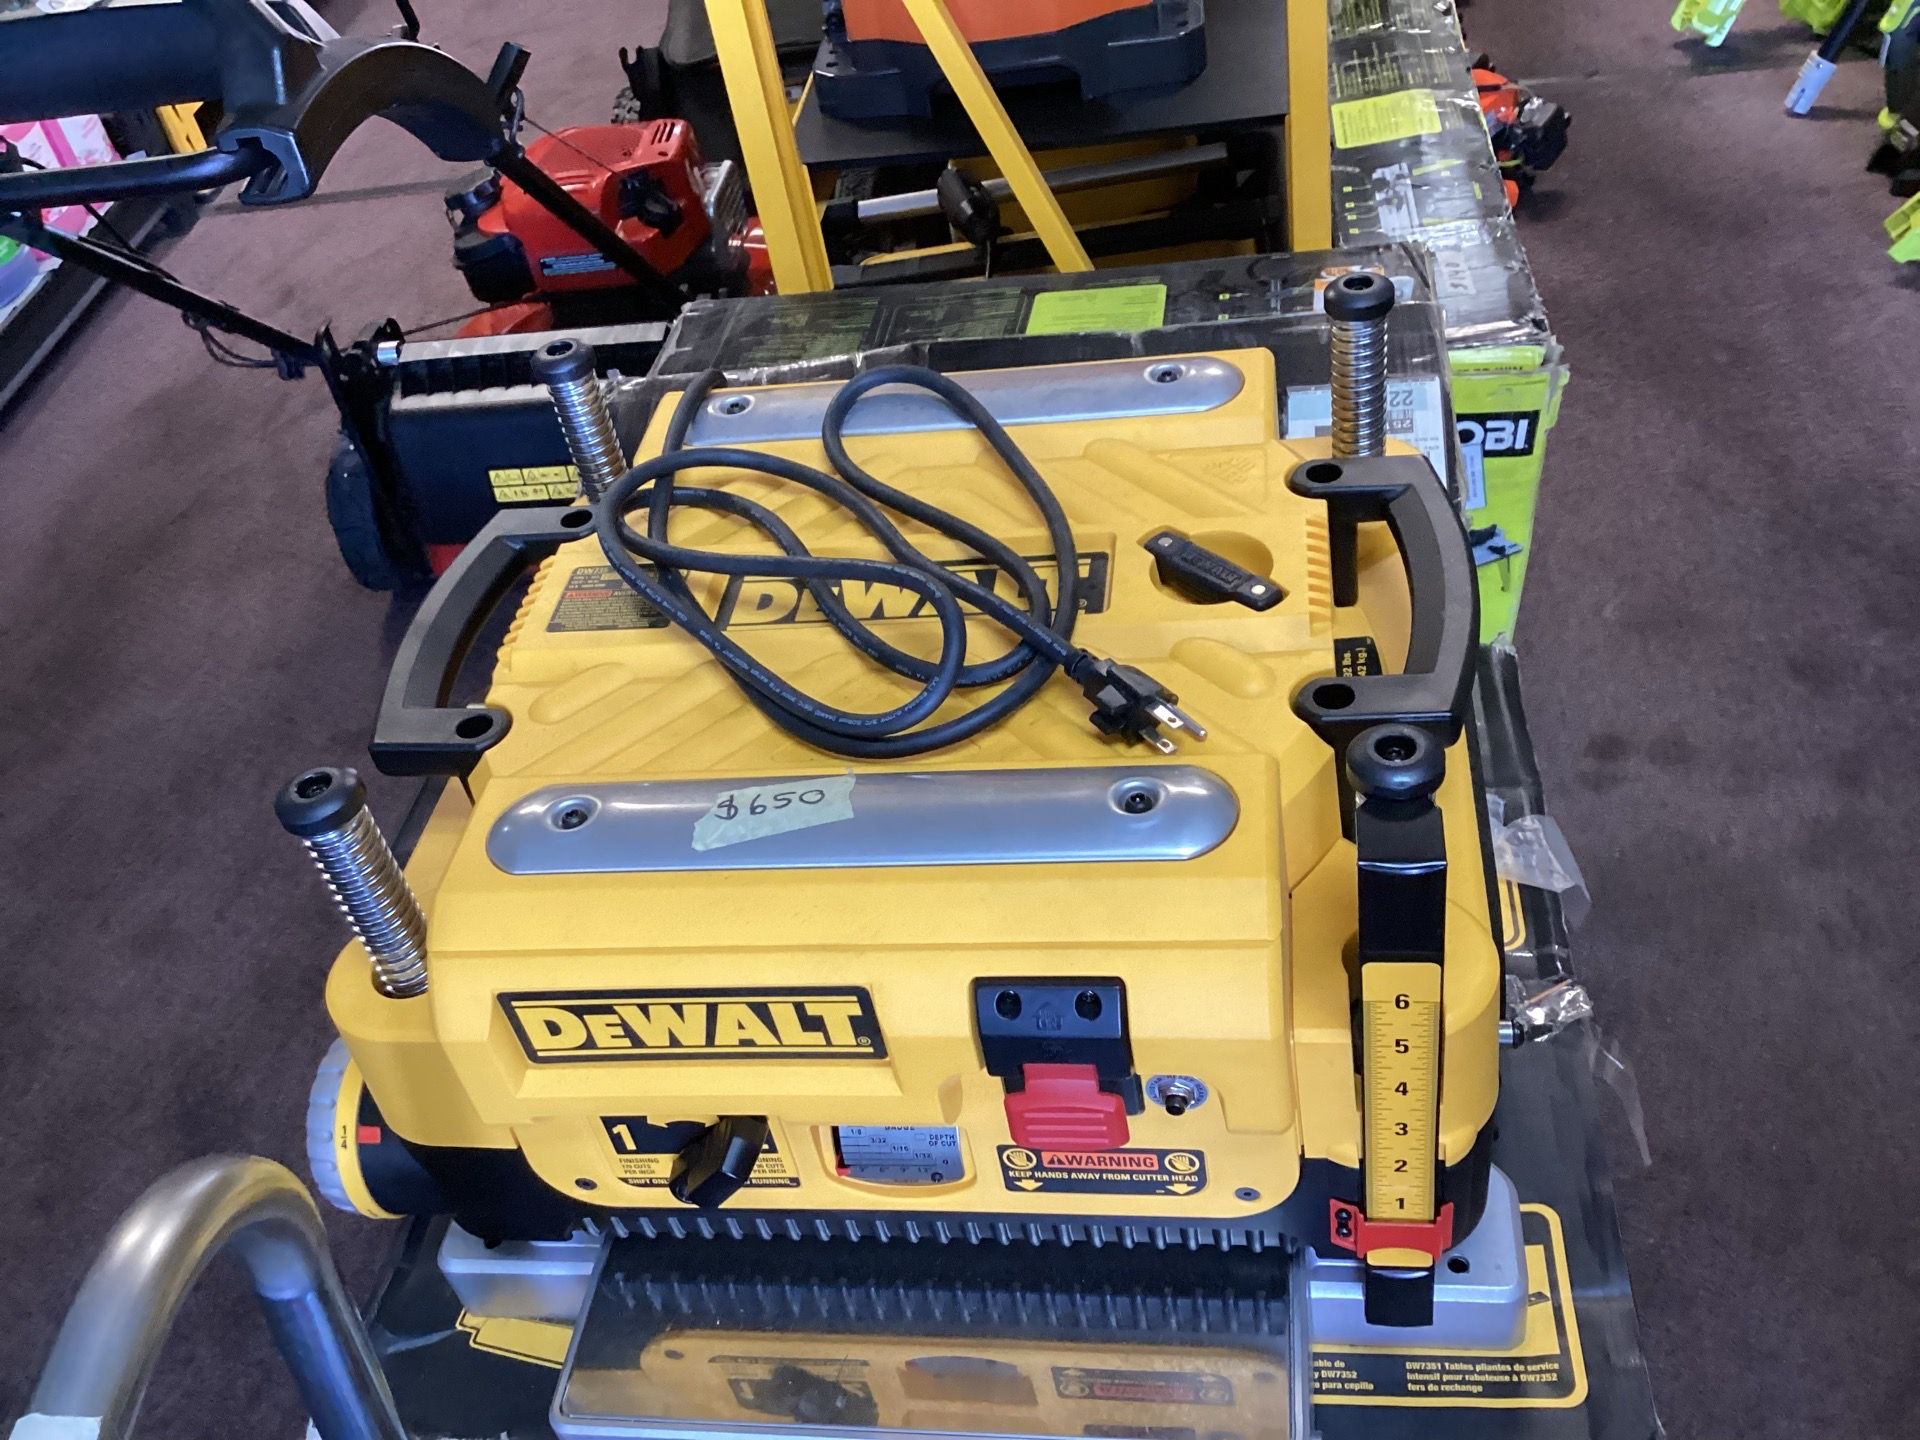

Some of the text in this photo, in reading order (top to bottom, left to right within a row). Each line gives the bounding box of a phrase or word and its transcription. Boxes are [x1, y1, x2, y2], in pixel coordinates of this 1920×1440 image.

[1457, 418, 1529, 451] OBI
[714, 789, 825, 820] $650
[1394, 993, 1410, 1009] 6
[1394, 1038, 1409, 1053] 5
[1394, 1081, 1409, 1096] 4
[1394, 1122, 1409, 1136] 3
[611, 1123, 637, 1150] 1
[1064, 1155, 1155, 1168] WARNING
[1393, 1159, 1408, 1173] 2
[1008, 1170, 1032, 1178] KEEP
[1035, 1171, 1068, 1179] HANDS
[1071, 1172, 1100, 1180] AWAY
[1103, 1173, 1131, 1181] FROM
[1133, 1174, 1169, 1182] CUTTER
[1395, 1197, 1405, 1210] 1
[1334, 1360, 1345, 1368] de
[1405, 1361, 1560, 1373] DW7351 Tables pliantes de service
[1321, 1371, 1358, 1379] DW7352
[1406, 1372, 1441, 1381] intensif
[1442, 1373, 1464, 1383] pour
[1465, 1373, 1510, 1382] raboteuse
[1520, 1373, 1559, 1382] DW7352
[1322, 1383, 1342, 1391] para
[1344, 1381, 1374, 1391] cepillo
[1407, 1383, 1483, 1393] fers de rechange
